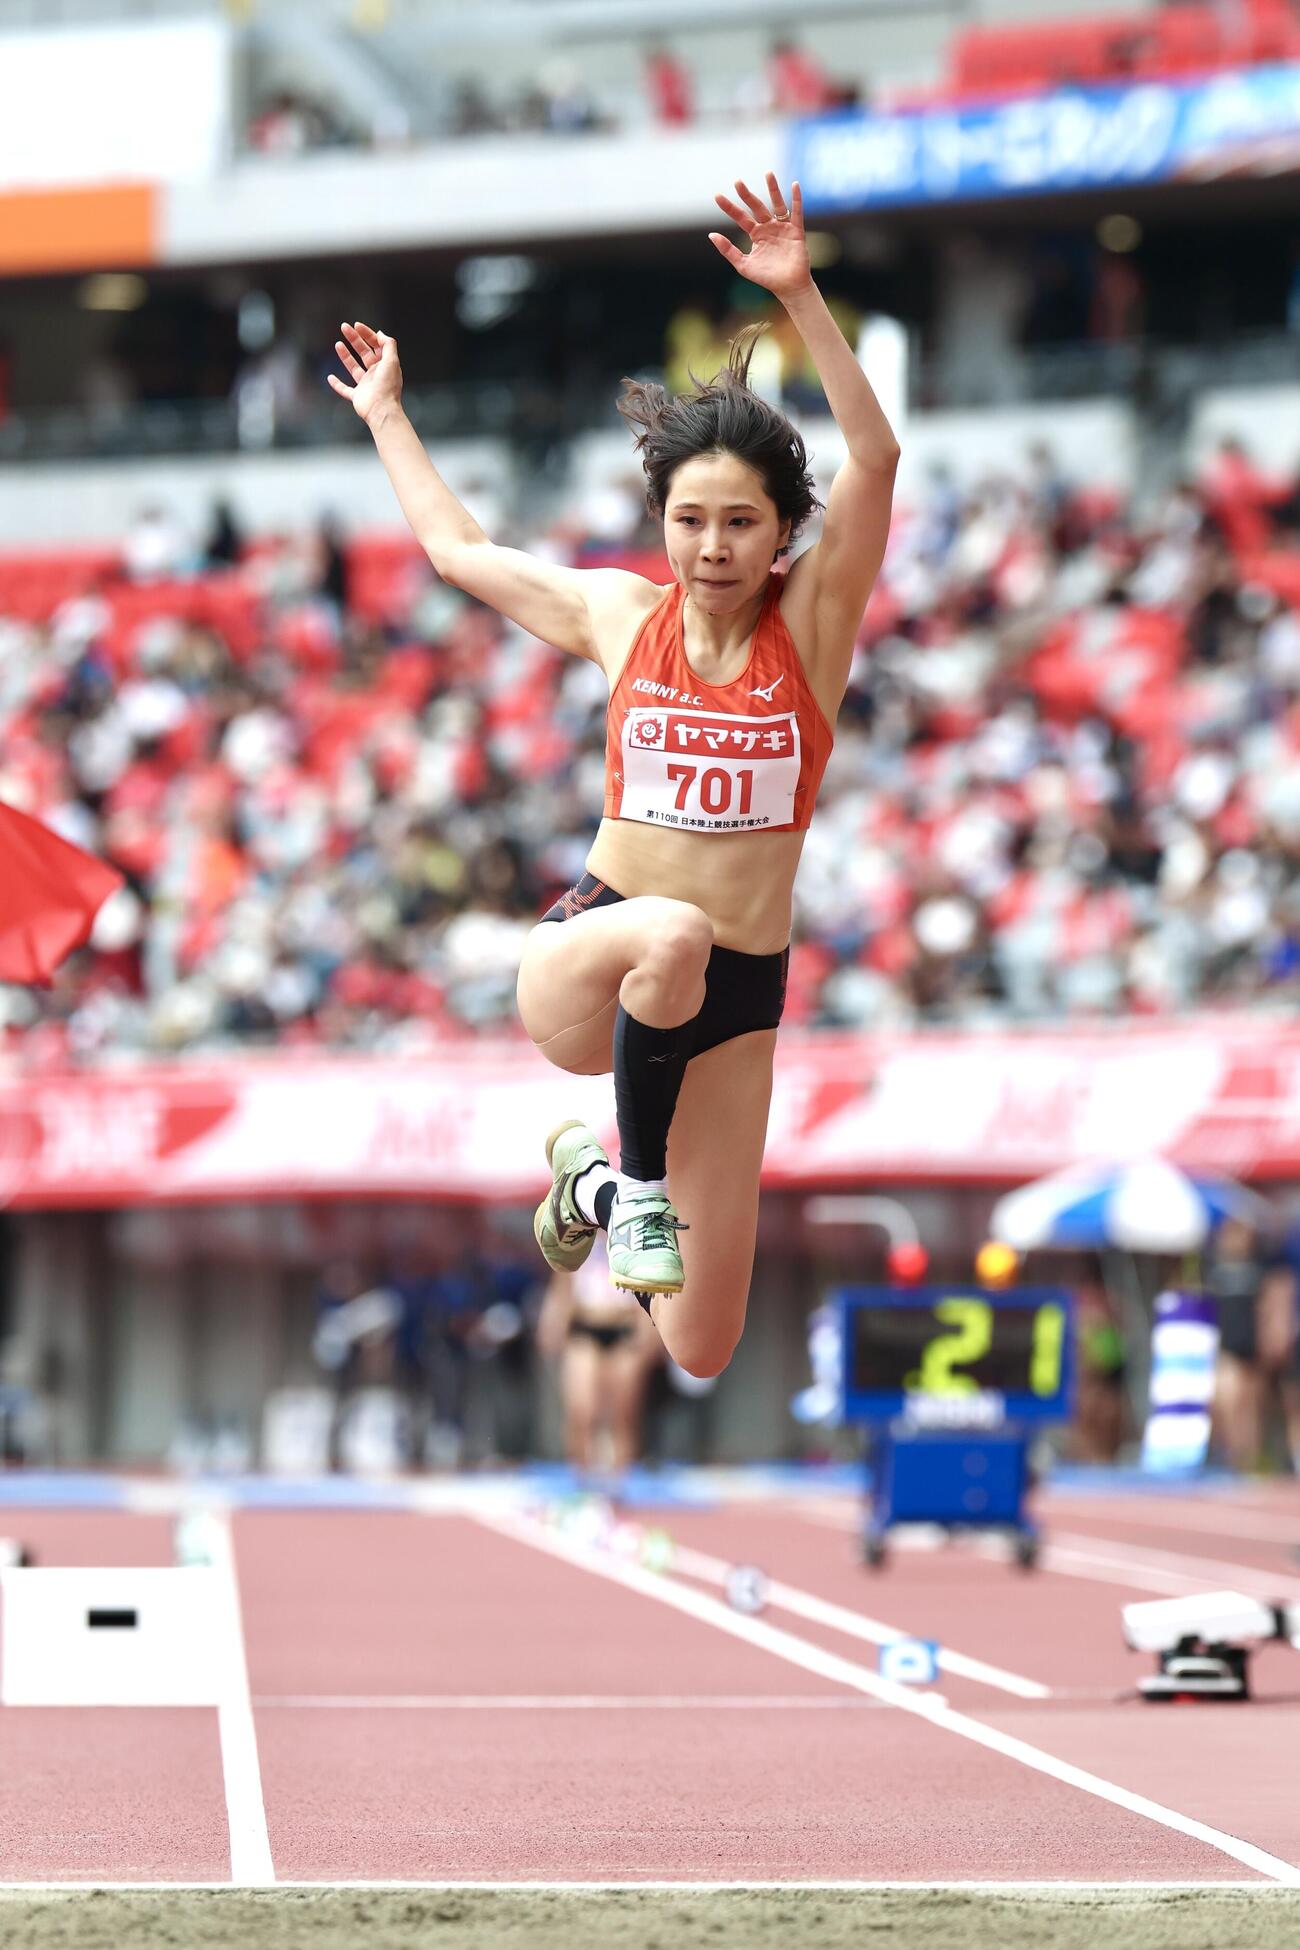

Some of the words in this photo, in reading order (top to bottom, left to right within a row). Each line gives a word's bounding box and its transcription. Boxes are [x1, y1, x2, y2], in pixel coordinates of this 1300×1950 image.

[633, 678, 679, 700] KENNY
[681, 693, 704, 706] a.c.
[674, 723, 787, 751] ヤマザキ
[667, 764, 753, 815] 701
[646, 810, 678, 824] 第110回
[681, 816, 769, 829] 日本陸上競技選手権大会
